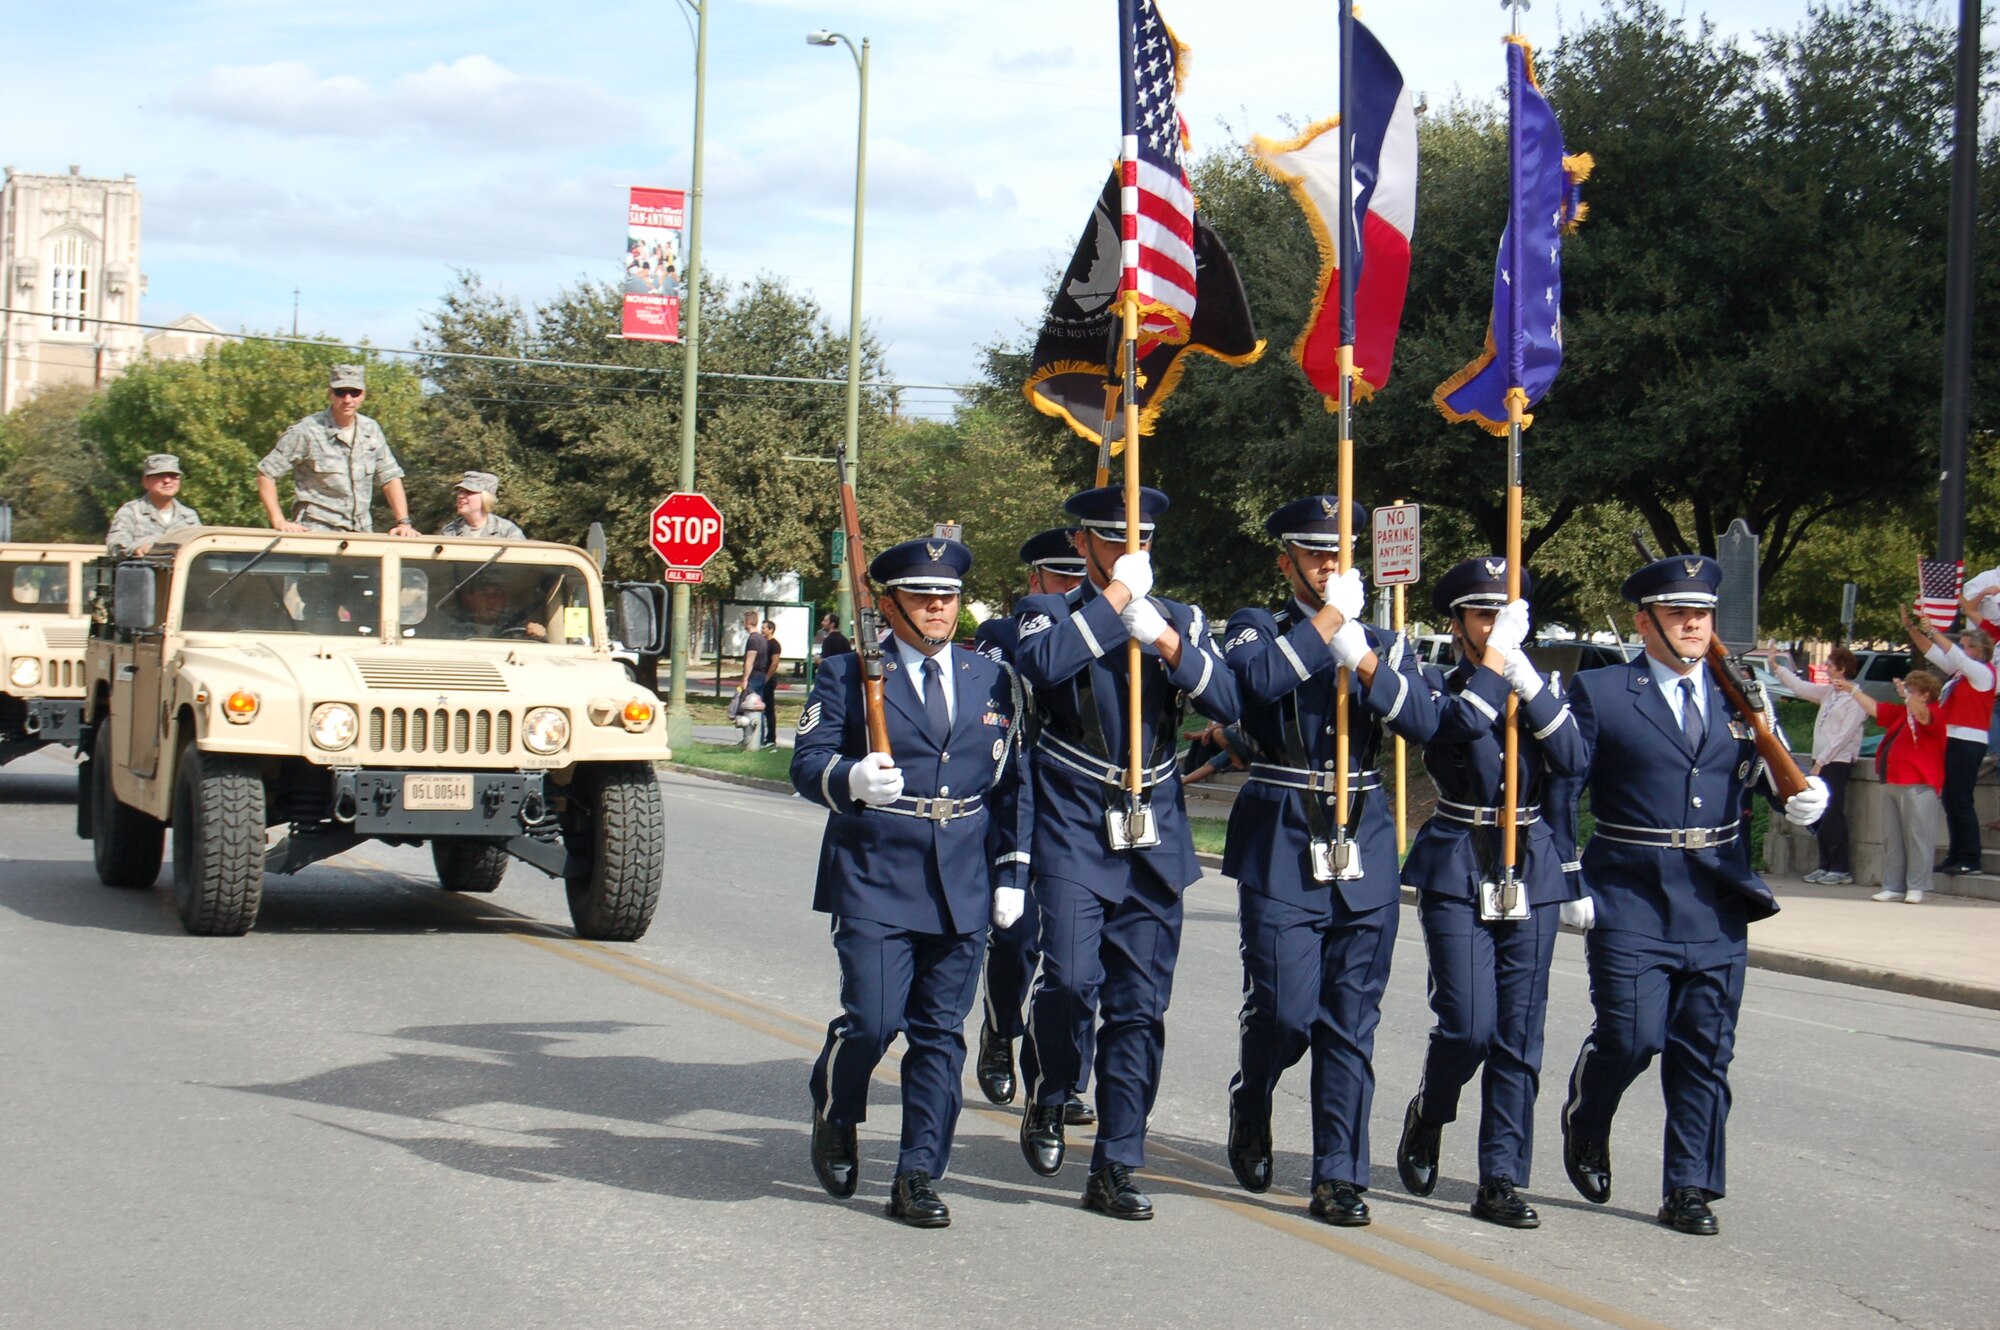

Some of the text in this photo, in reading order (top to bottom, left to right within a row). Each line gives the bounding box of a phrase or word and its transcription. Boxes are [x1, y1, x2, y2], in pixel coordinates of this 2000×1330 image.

[625, 295, 668, 305] NOVEMBER
[1042, 326, 1064, 337] ARE
[1067, 329, 1086, 339] NOT
[1387, 511, 1405, 526] NO
[655, 515, 718, 545] STOP
[942, 528, 953, 539] NO
[1377, 527, 1415, 544] PARKING
[1379, 544, 1413, 558] ANYTIME
[668, 571, 700, 581] ALL WAY
